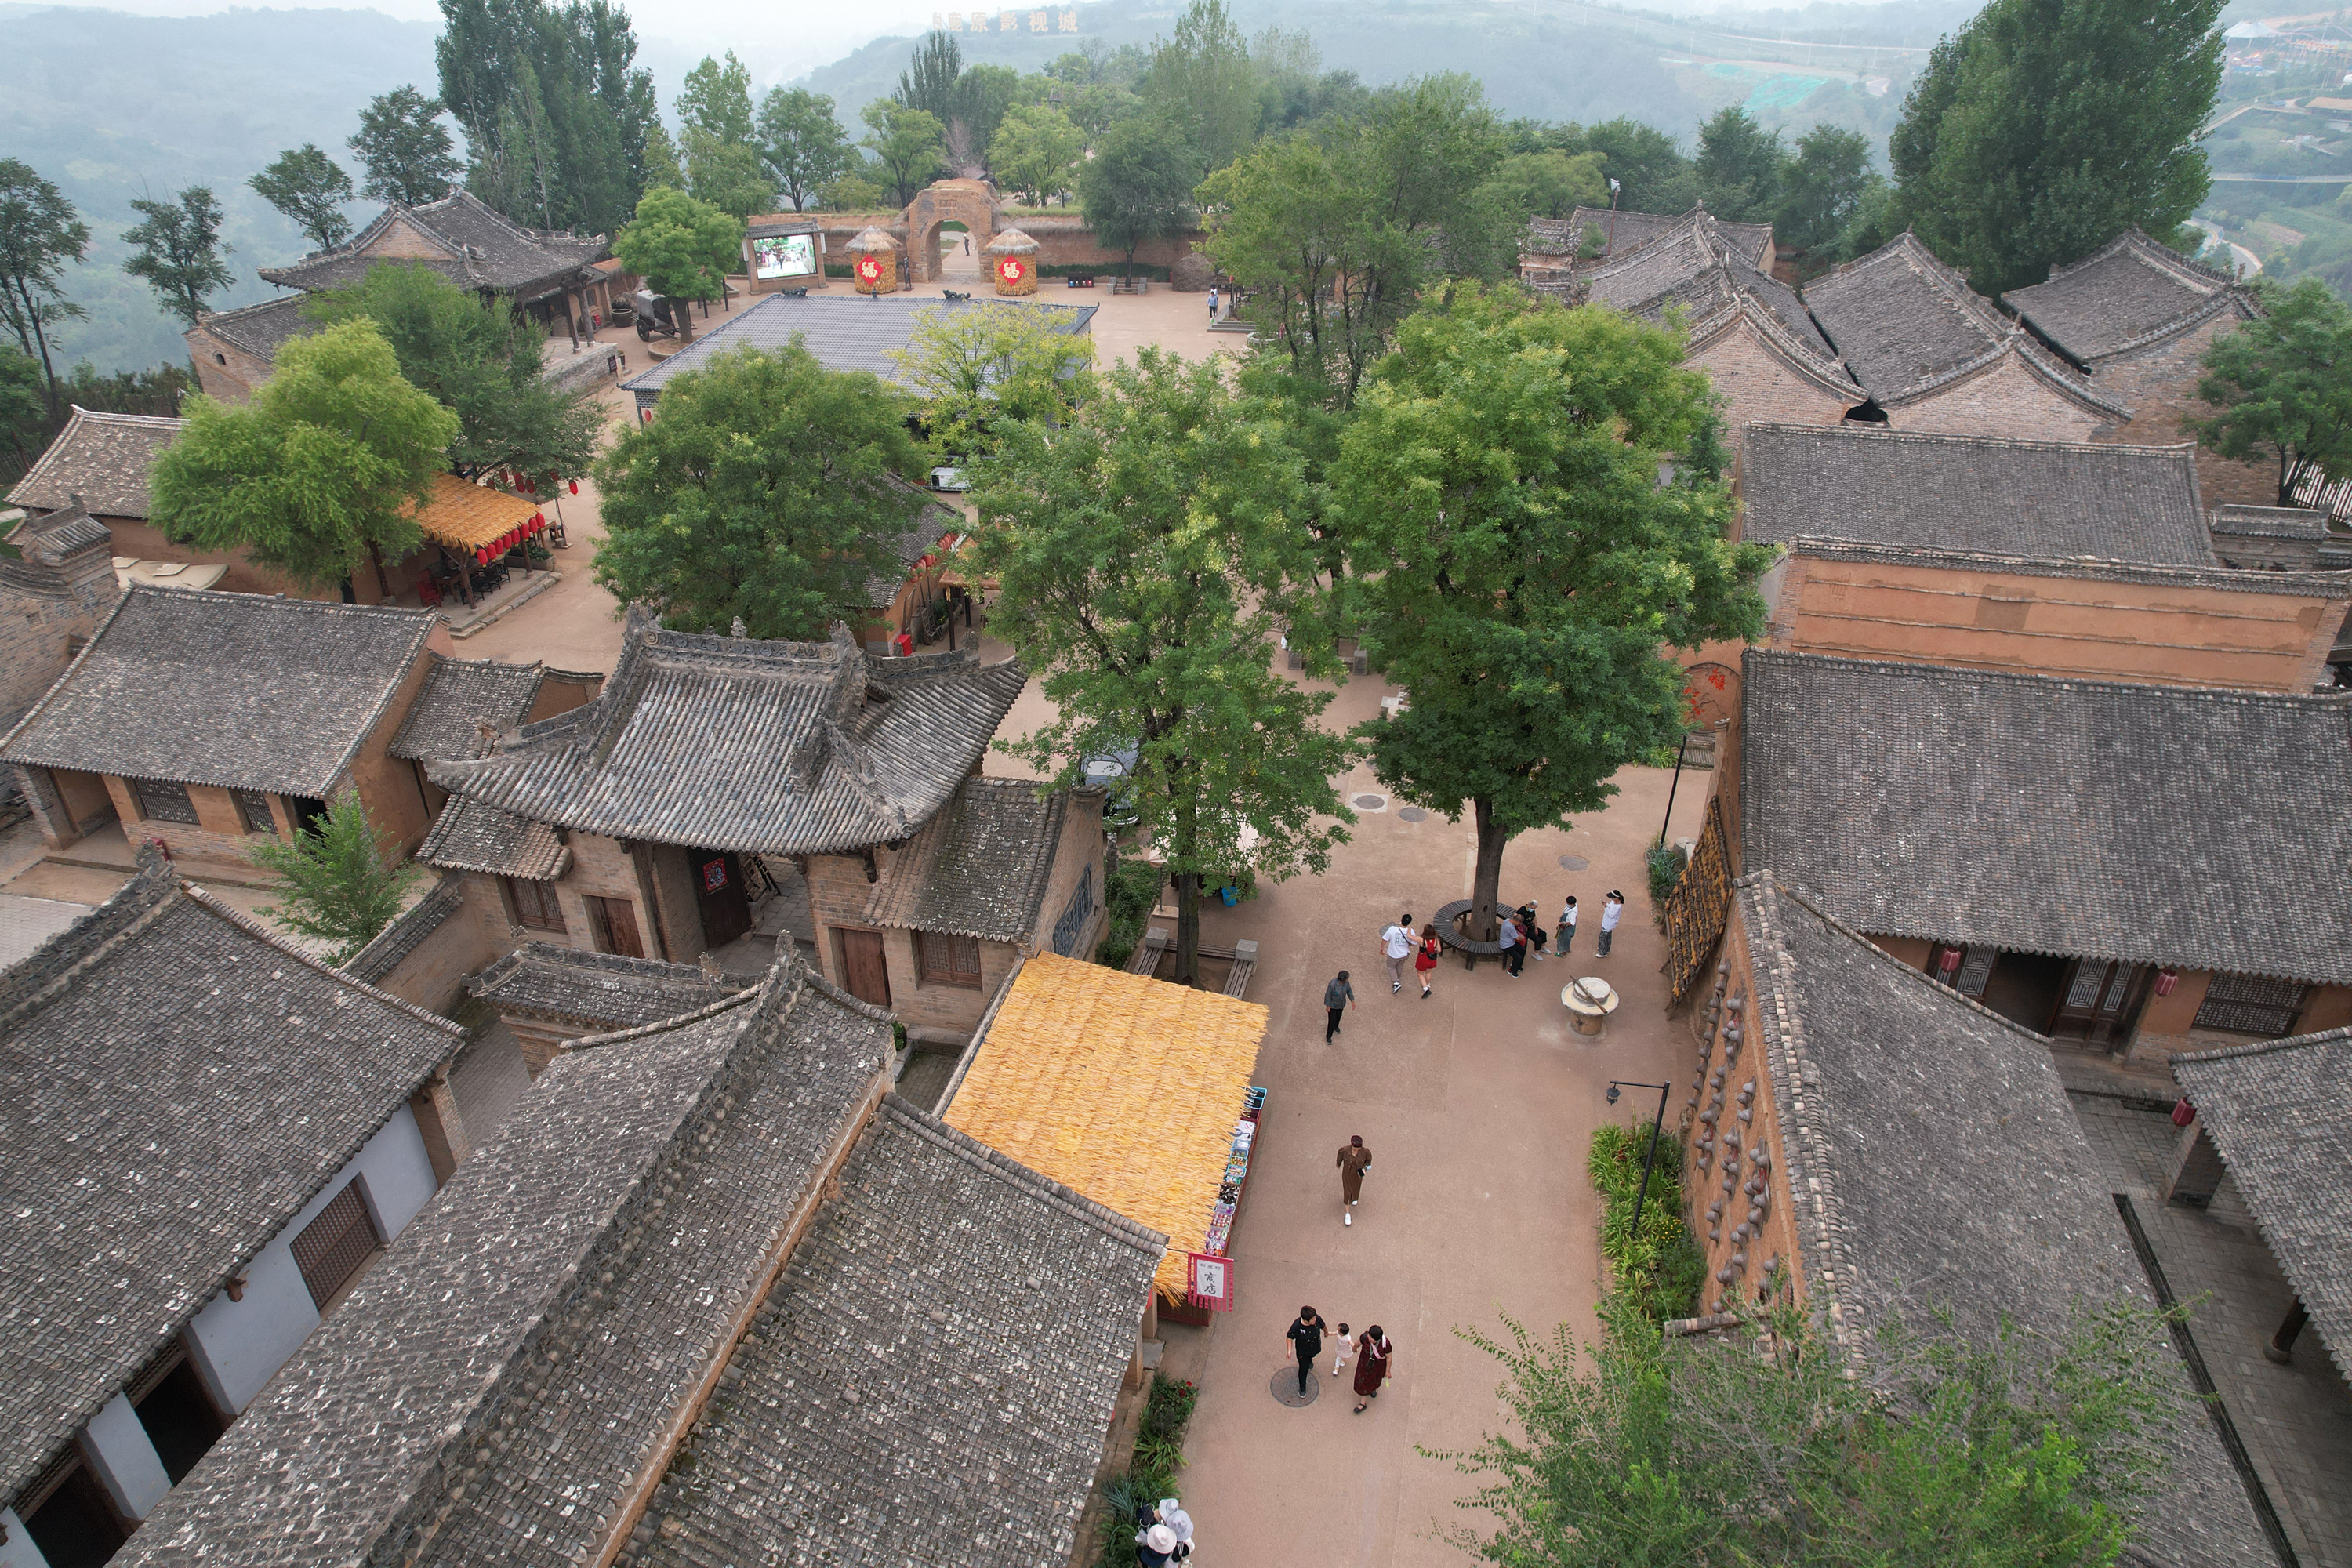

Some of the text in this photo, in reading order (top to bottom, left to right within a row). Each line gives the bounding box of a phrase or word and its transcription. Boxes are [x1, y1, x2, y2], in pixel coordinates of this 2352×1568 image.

[862, 261, 878, 278] 福
[1004, 262, 1020, 279] 福
[1204, 1272, 1217, 1294] 商店
